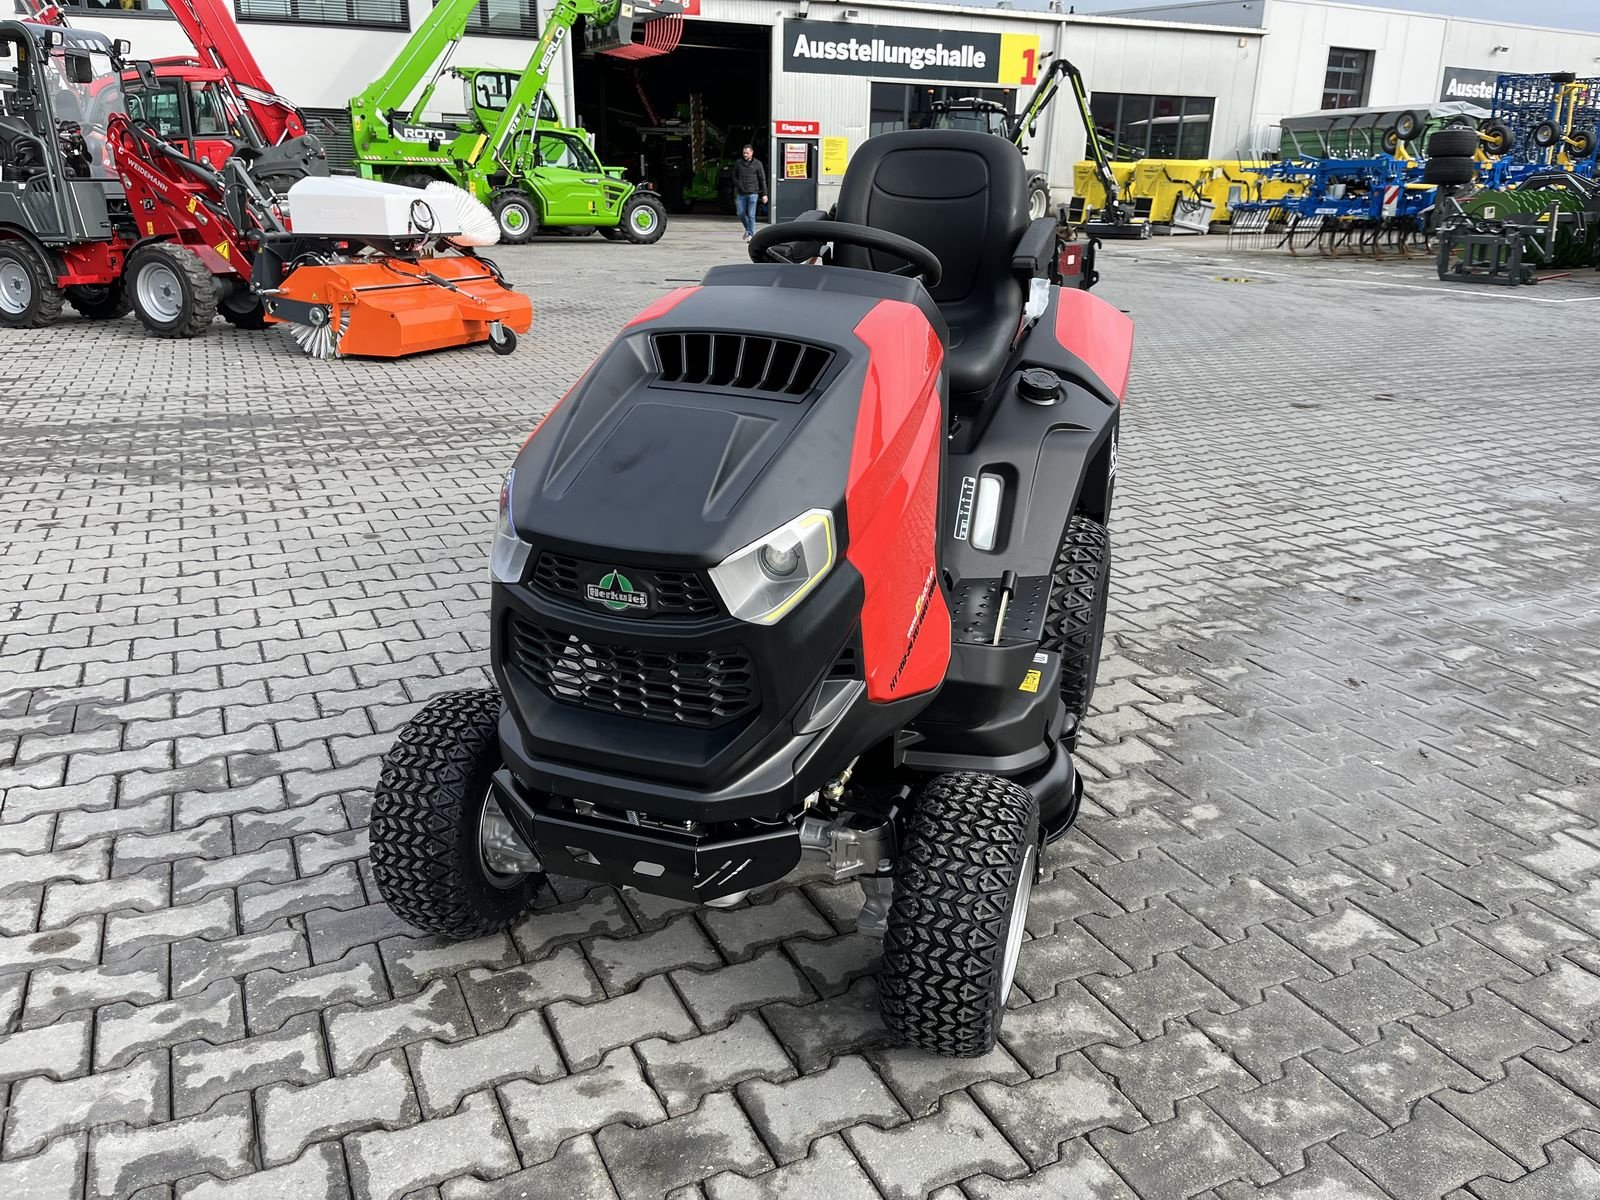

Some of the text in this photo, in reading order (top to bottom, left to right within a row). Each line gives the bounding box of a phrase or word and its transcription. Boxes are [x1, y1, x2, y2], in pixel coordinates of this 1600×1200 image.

[536, 25, 566, 76] MERLO
[793, 34, 1037, 86] Ausstellungshalle 1
[404, 128, 447, 140] ROTO
[128, 157, 169, 193] WEIDEMANN
[589, 587, 646, 604] Herkules
